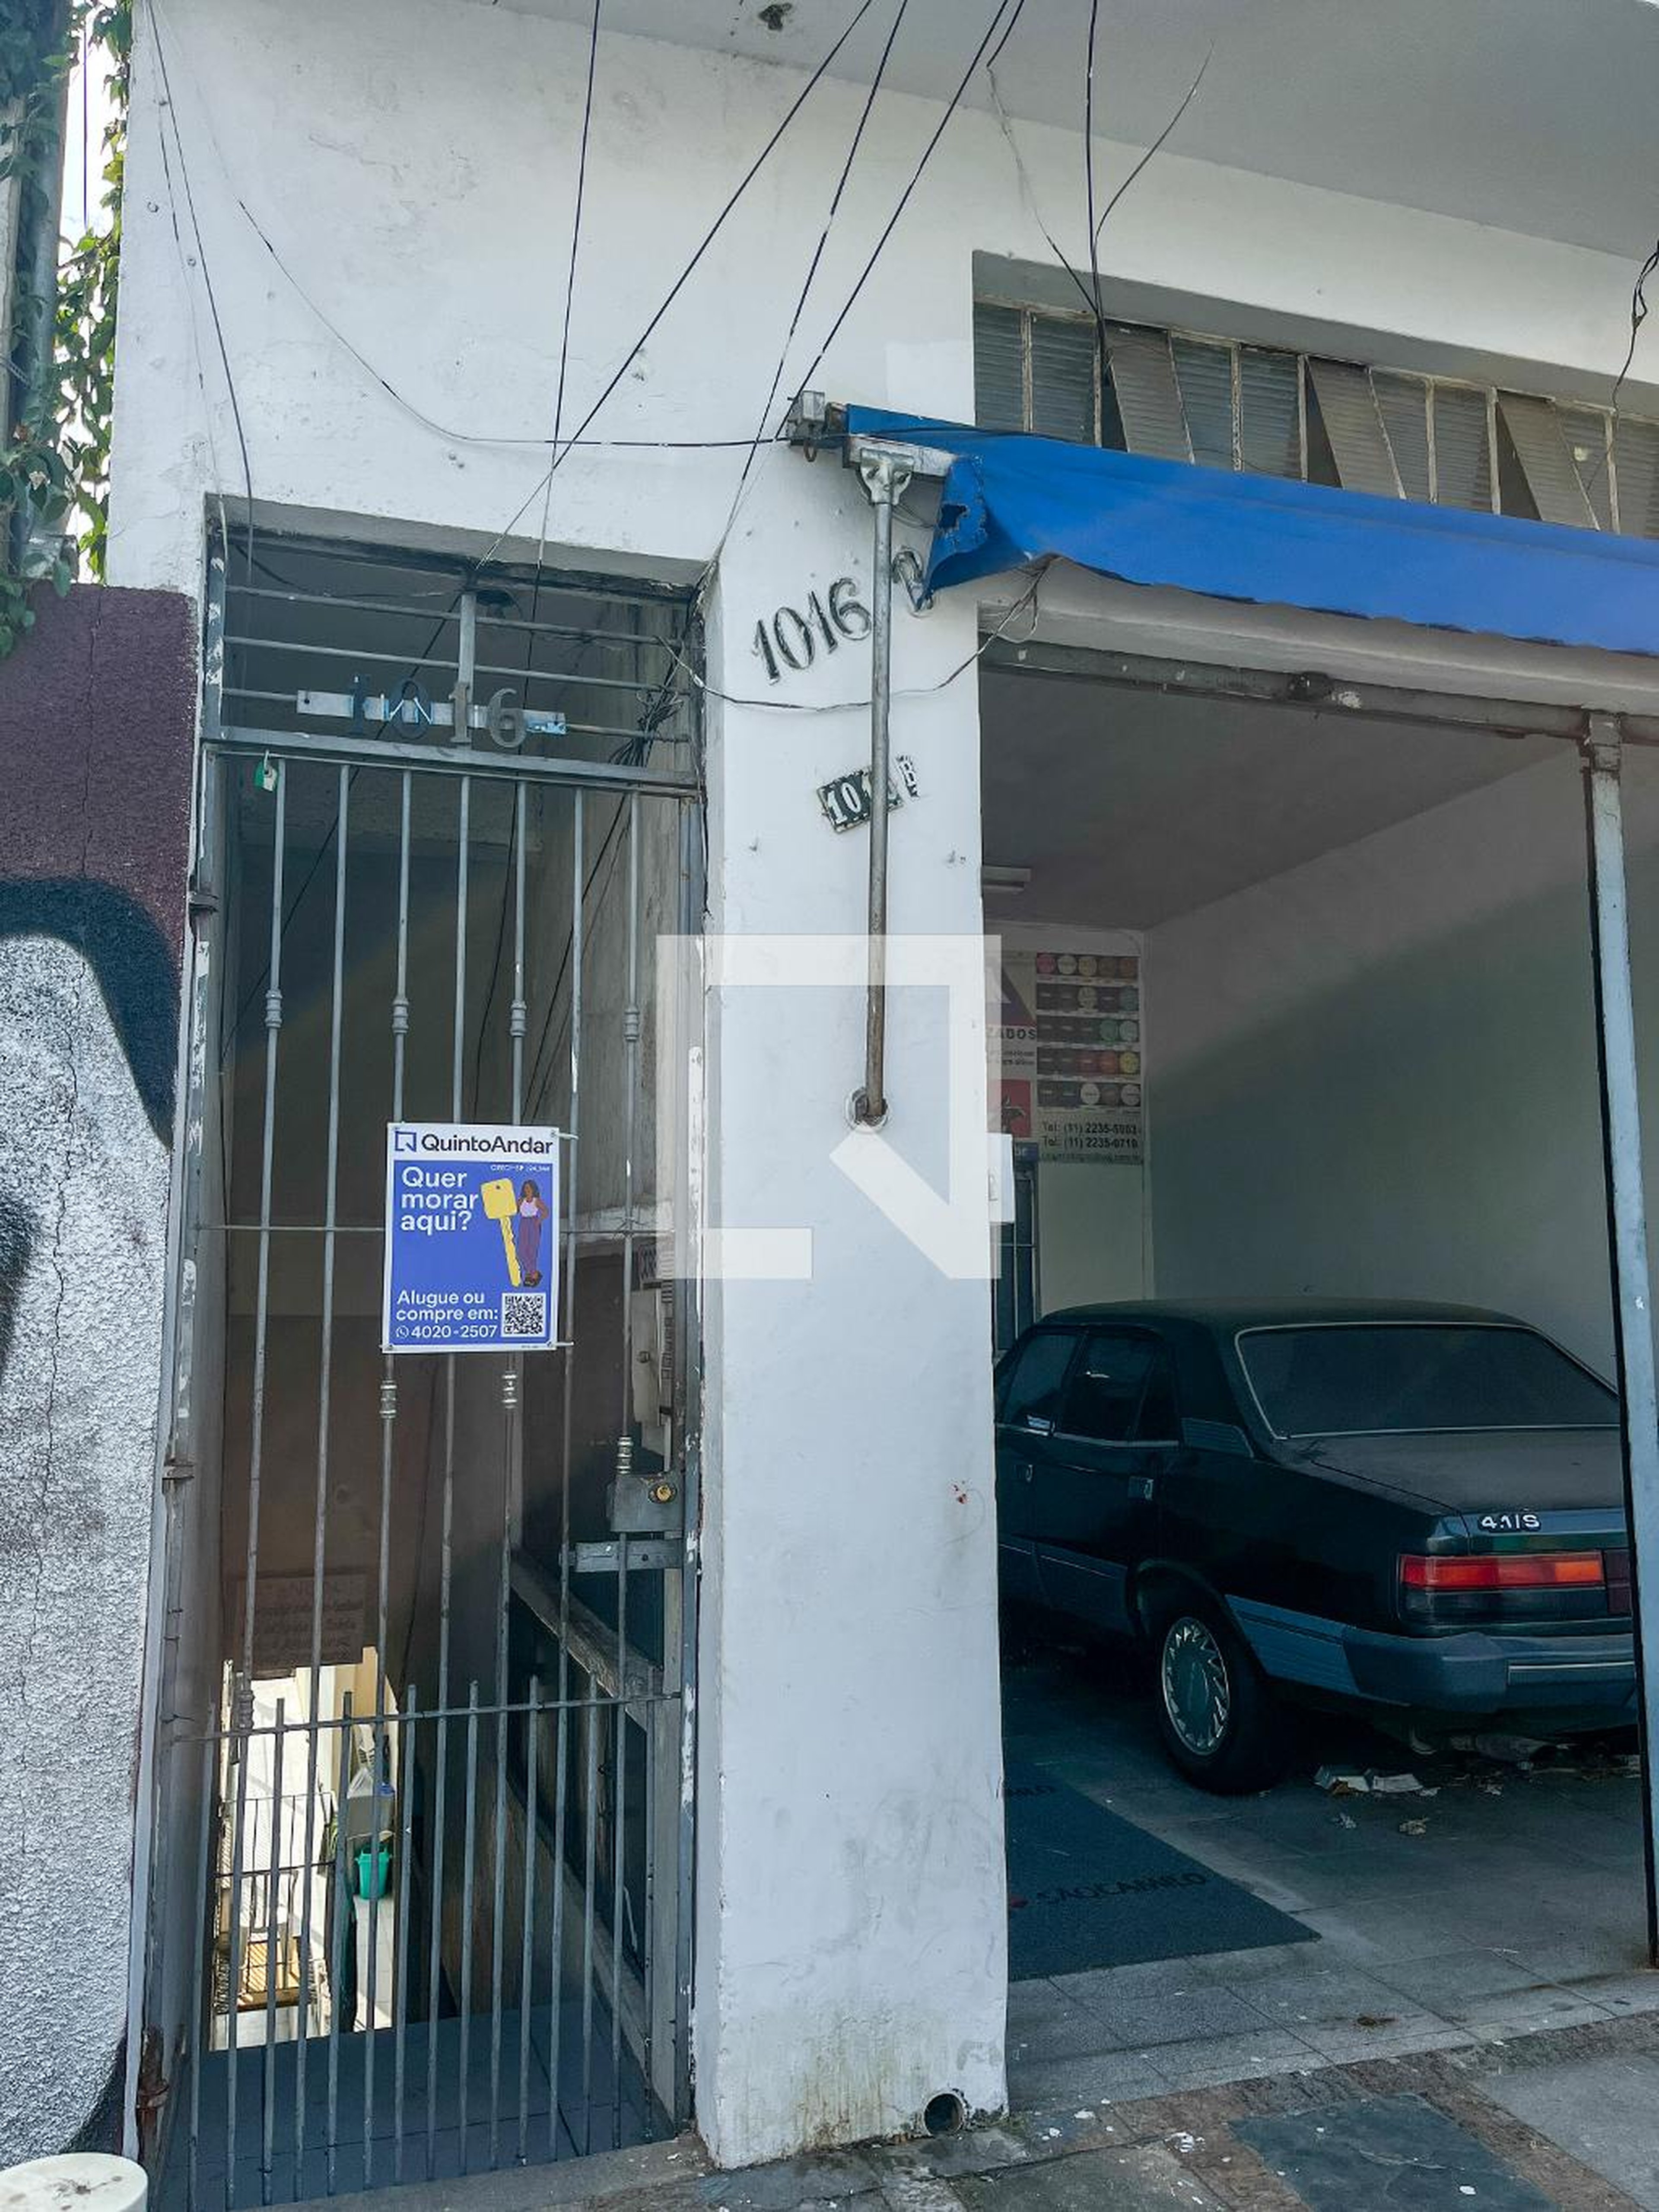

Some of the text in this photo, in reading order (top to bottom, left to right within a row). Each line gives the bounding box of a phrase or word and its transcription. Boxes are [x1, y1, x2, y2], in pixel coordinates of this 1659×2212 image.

[752, 577, 872, 685] 1016
[352, 674, 527, 748] 1016
[421, 1134, 553, 1154] QuintoAndar
[402, 1166, 467, 1188] Quer
[401, 1193, 479, 1209] morar
[400, 1210, 472, 1235] aqui?
[396, 1290, 484, 1307] Alugue ou
[396, 1308, 499, 1324] compre em:
